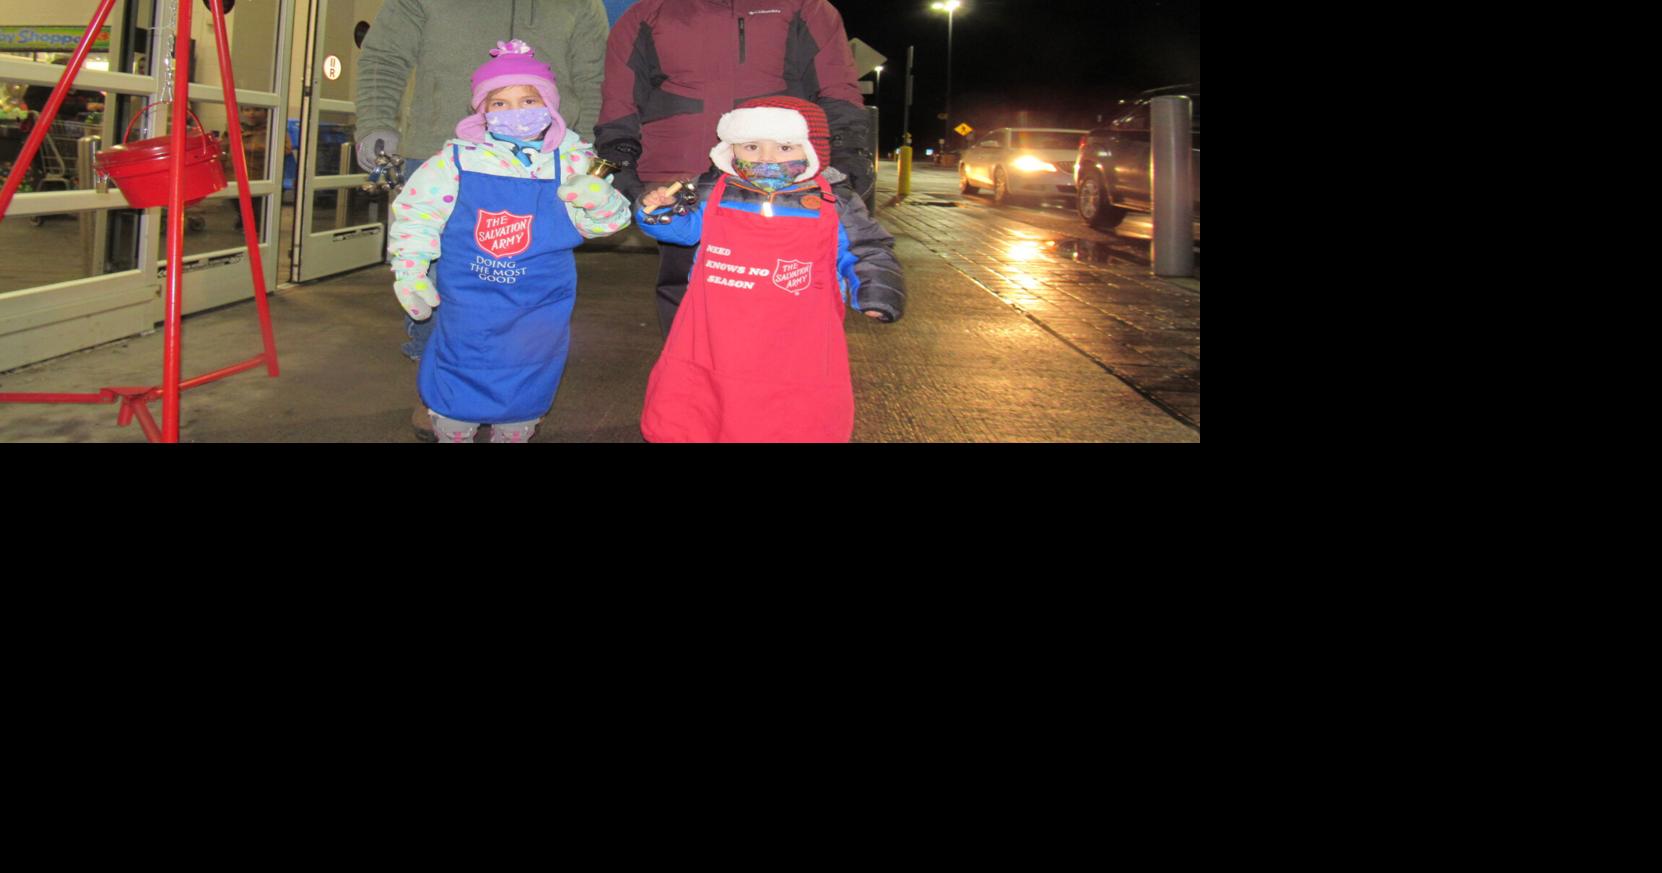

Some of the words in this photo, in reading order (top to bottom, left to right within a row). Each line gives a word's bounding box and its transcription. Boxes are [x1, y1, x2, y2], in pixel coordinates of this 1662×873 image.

[486, 215, 508, 228] THE
[479, 219, 528, 242] SALVATION
[491, 233, 524, 251] ARMY
[469, 262, 490, 275] THE
[493, 267, 527, 277] MOST
[476, 255, 516, 269] DOING
[705, 260, 746, 274] KNOWS
[748, 267, 770, 277] NO
[782, 262, 799, 273] THE
[478, 273, 516, 284] GOOD
[706, 275, 755, 290] SEASON
[786, 274, 808, 289] ARMY
